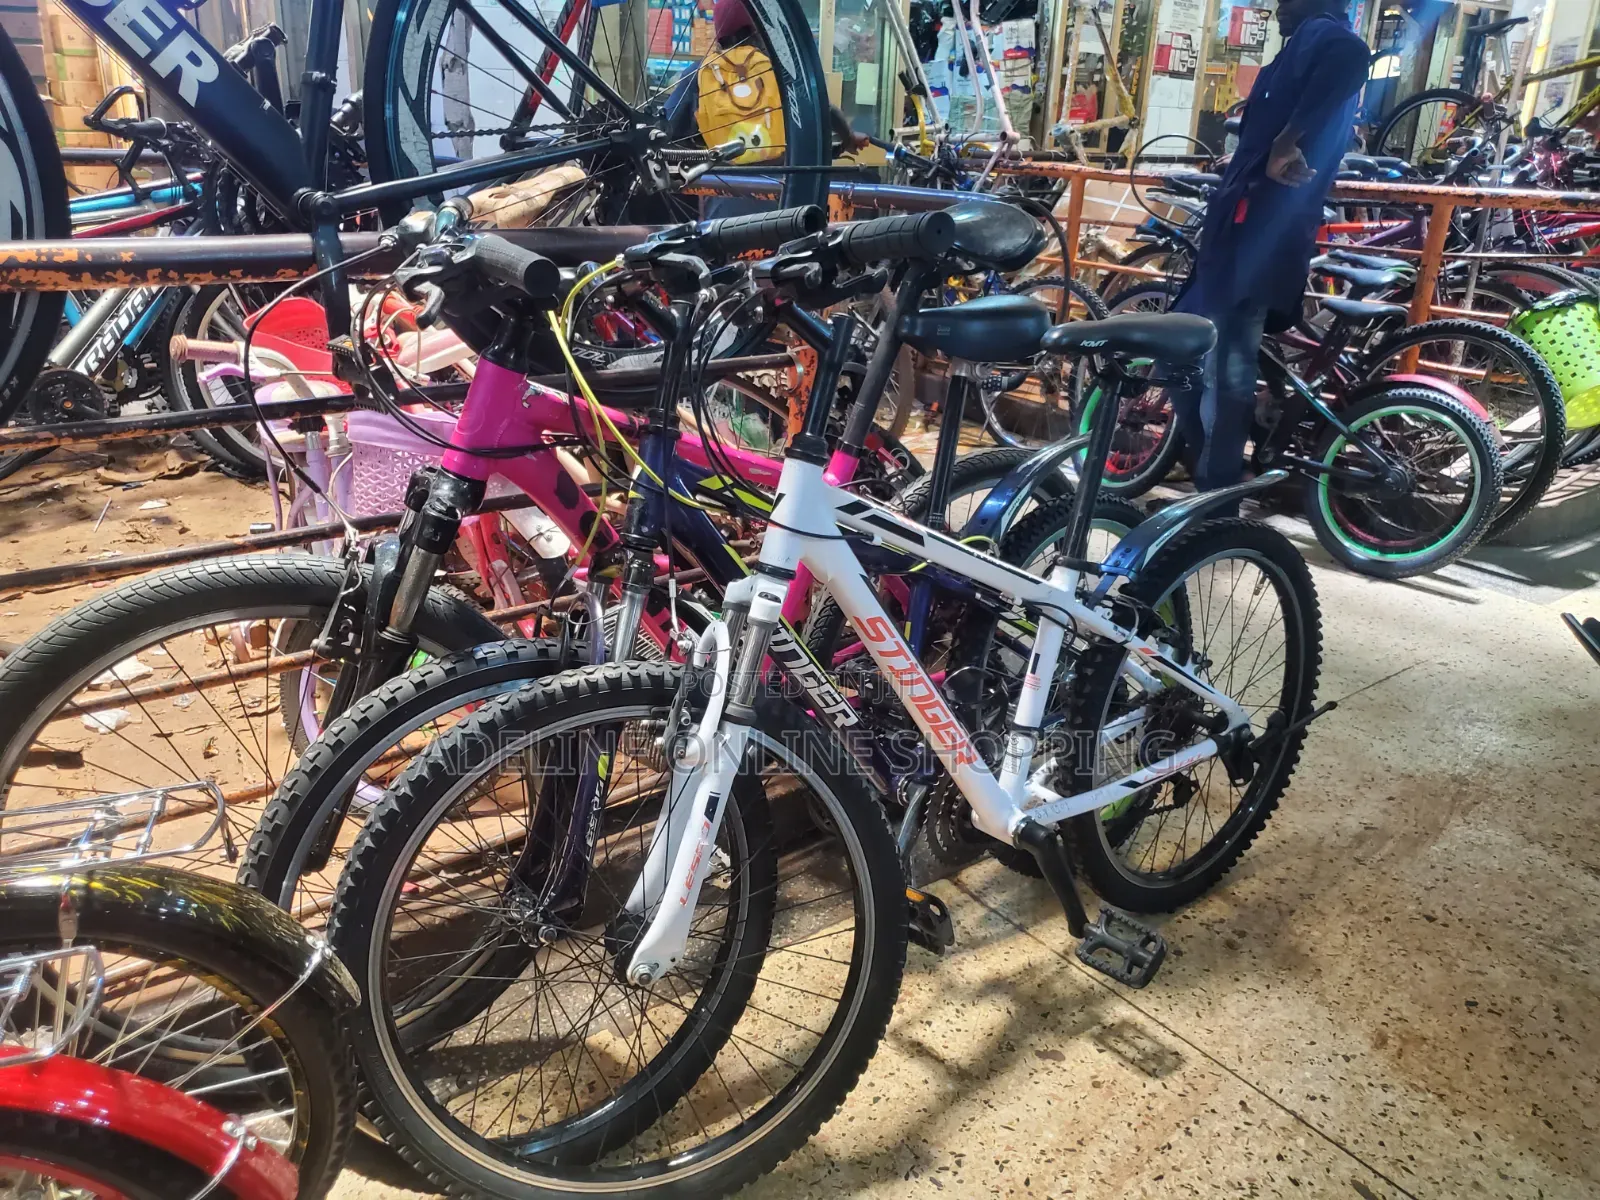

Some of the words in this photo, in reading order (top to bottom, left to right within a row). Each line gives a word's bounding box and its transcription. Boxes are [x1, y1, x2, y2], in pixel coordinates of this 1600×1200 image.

[81, 0, 219, 108] ER
[786, 83, 802, 129] 700
[769, 622, 859, 728] INGER
[853, 615, 979, 767] STINGER
